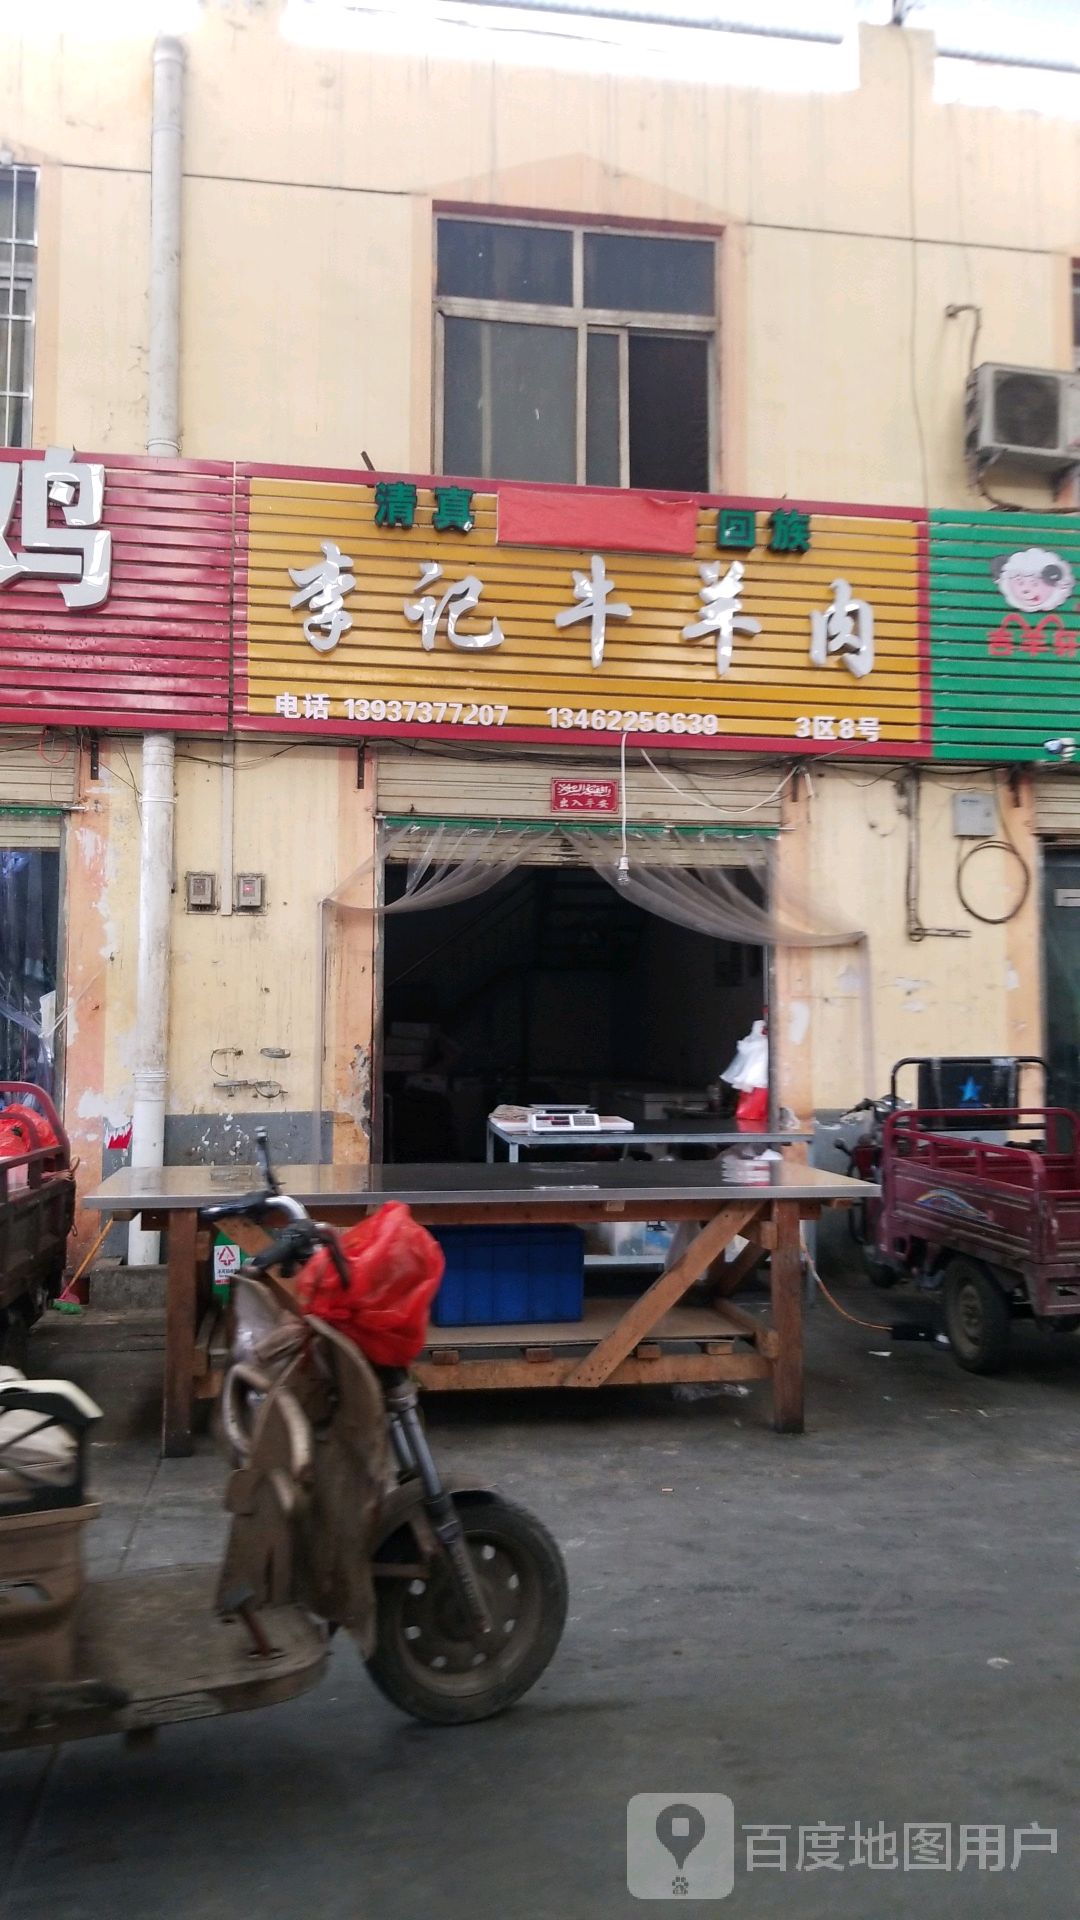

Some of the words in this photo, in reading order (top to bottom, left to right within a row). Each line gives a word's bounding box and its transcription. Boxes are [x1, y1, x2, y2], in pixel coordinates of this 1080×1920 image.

[375, 481, 475, 534] 清真
[717, 508, 811, 554] 回族
[288, 541, 875, 680] 李记牛羊肉
[275, 692, 331, 721] 电话
[344, 698, 509, 727] 13937377207
[546, 708, 719, 735] 13462256639
[795, 716, 881, 743] 3区8号
[560, 798, 609, 808] 出入平安
